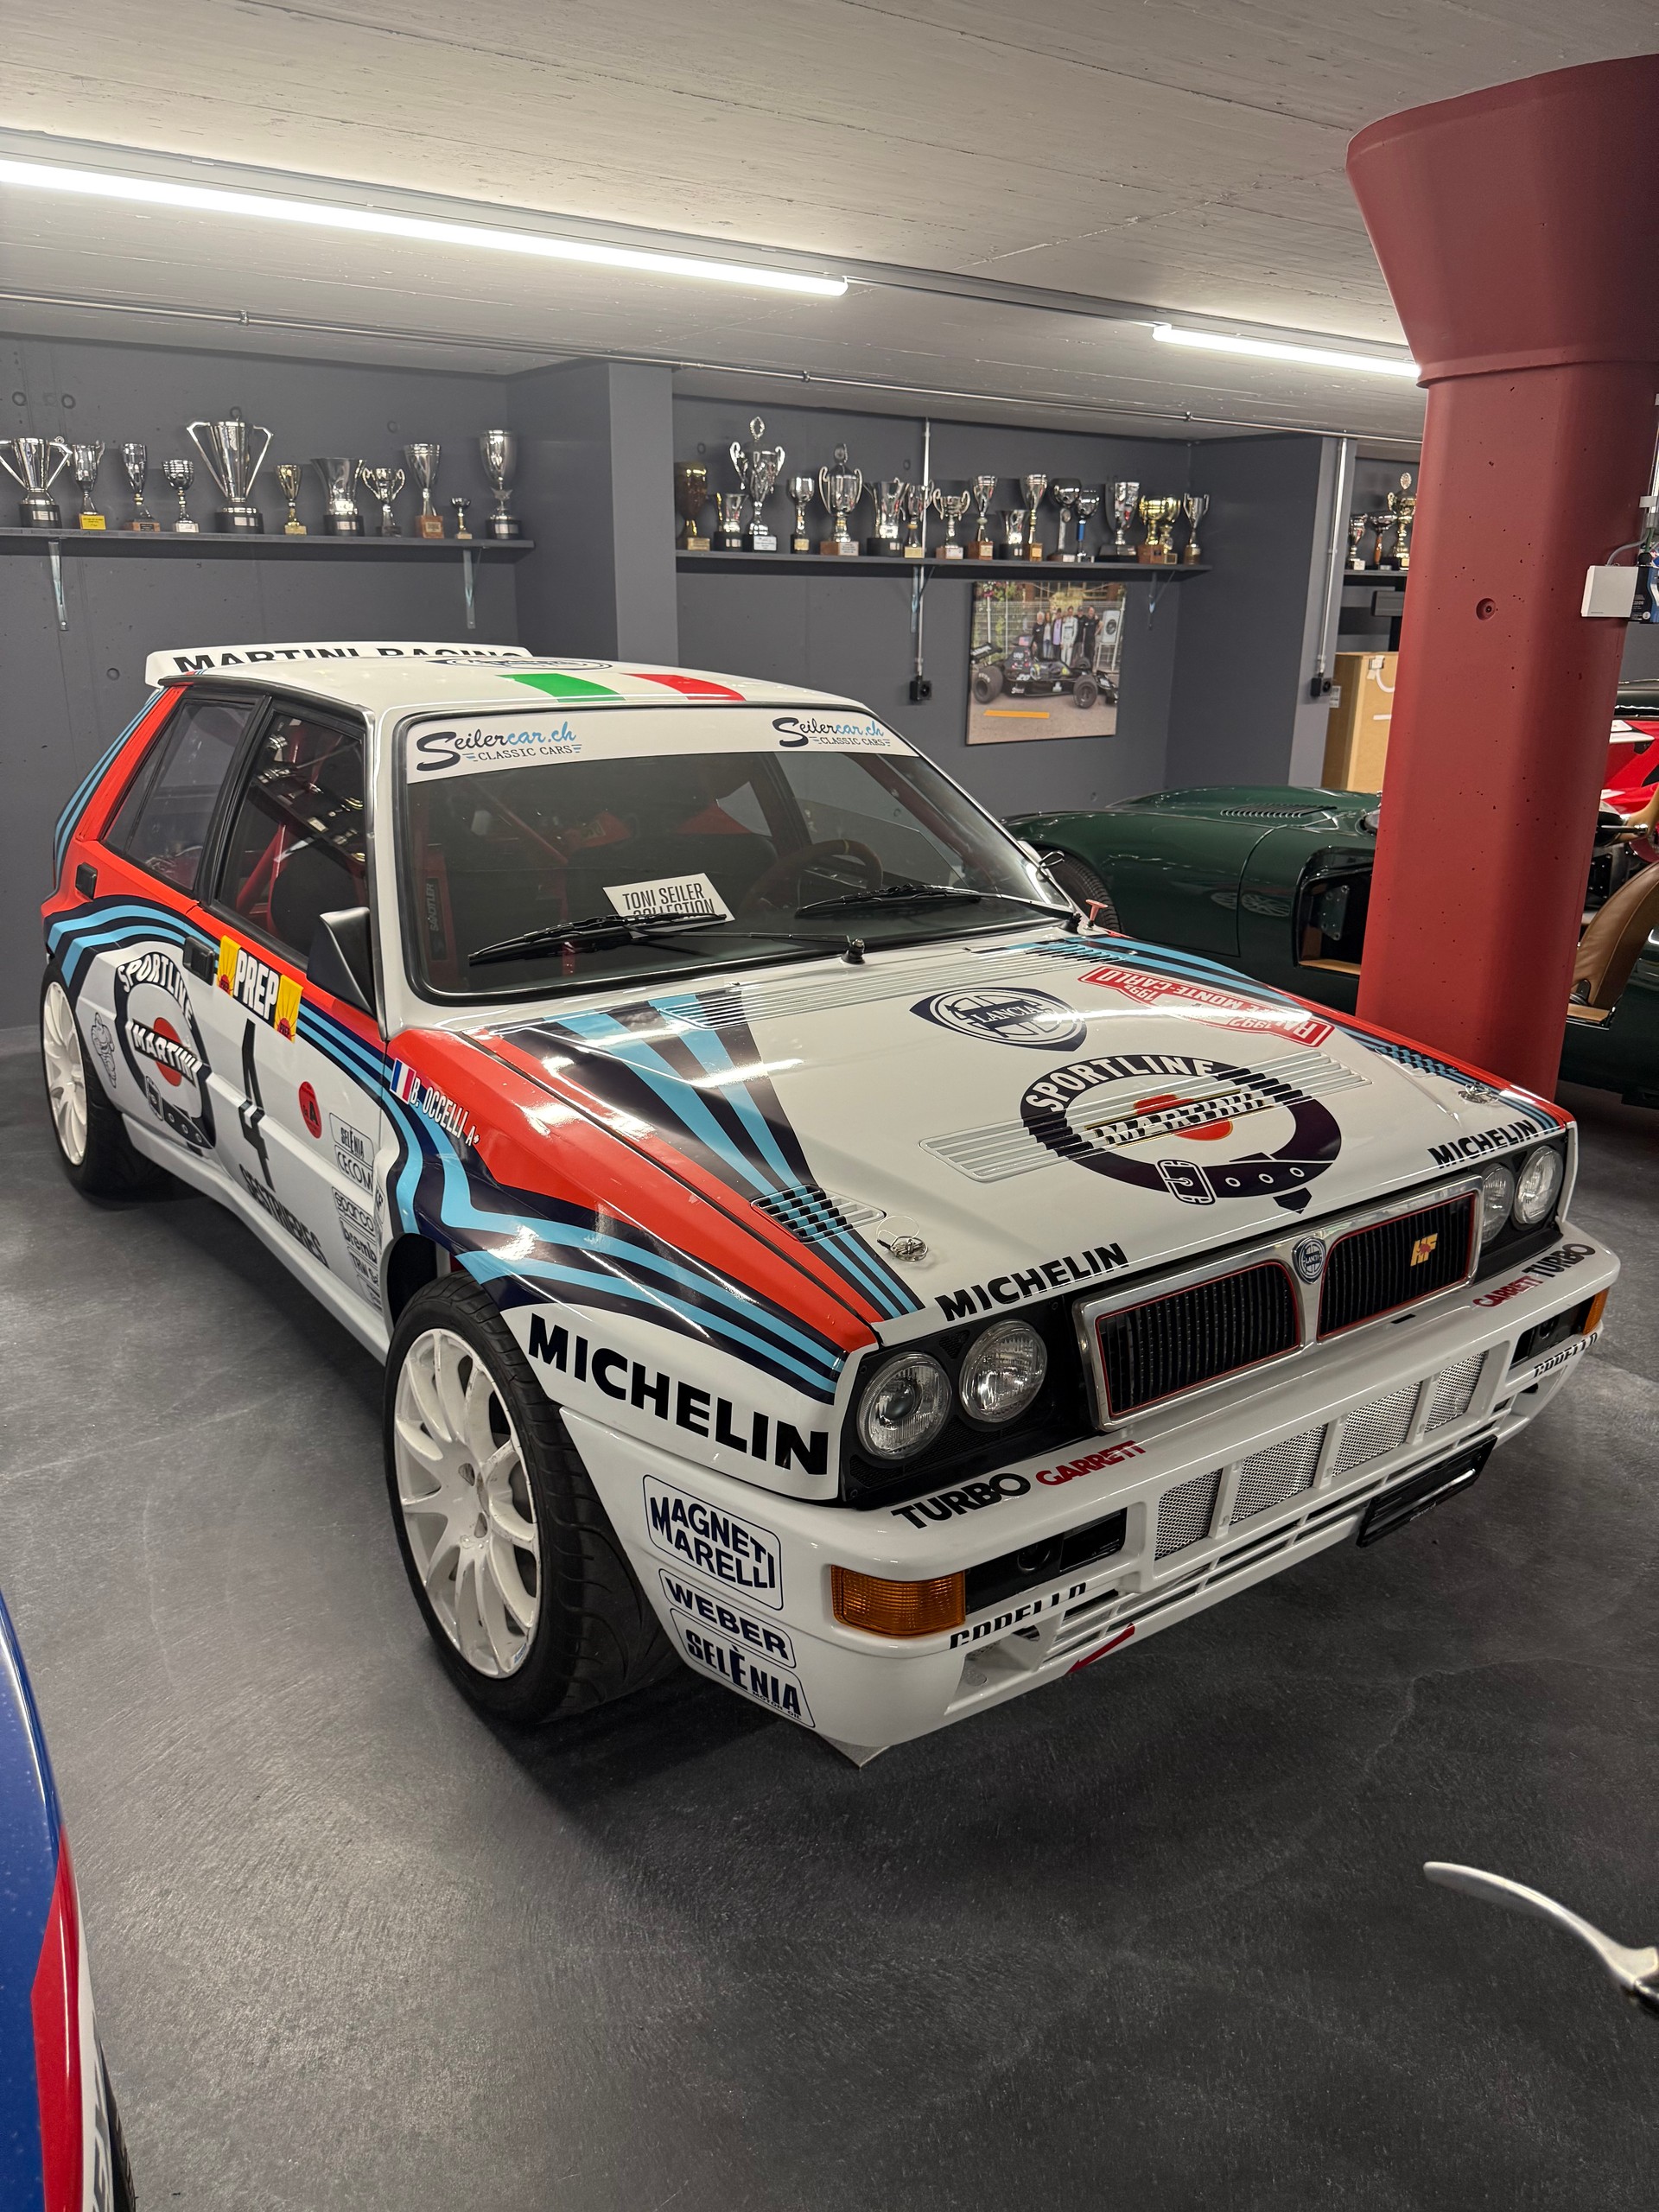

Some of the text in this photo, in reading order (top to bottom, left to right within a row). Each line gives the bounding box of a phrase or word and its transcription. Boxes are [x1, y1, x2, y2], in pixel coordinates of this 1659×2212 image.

[173, 648, 359, 673] MARTINI
[478, 745, 574, 761] CLASSIC CARS
[820, 737, 885, 747] CLASSIC CARS
[622, 883, 705, 910] TONI SEILER
[633, 899, 715, 915] ECTION
[118, 953, 194, 1028] SPORTLINE
[233, 949, 280, 1020] PREP
[1096, 970, 1244, 1008] MONTE-CARLO
[971, 1005, 1043, 1023] LANCIA
[132, 1024, 204, 1081] MARTINI
[410, 1077, 421, 1107] B.
[423, 1086, 469, 1139] OCCELLI
[1033, 1055, 1215, 1112] SPORTLINE
[1094, 1092, 1264, 1146] MARTINI
[1427, 1119, 1538, 1169] MICHELIN
[340, 1218, 378, 1264] bremb
[934, 1242, 1129, 1322] MICHELIN
[1472, 1243, 1596, 1307] GARRETT TURBO
[528, 1313, 829, 1476] MICHELIN
[891, 1440, 1147, 1529] TURBO GARRETT
[650, 1497, 775, 1577] MAGNETI
[664, 1576, 789, 1661] WEBER
